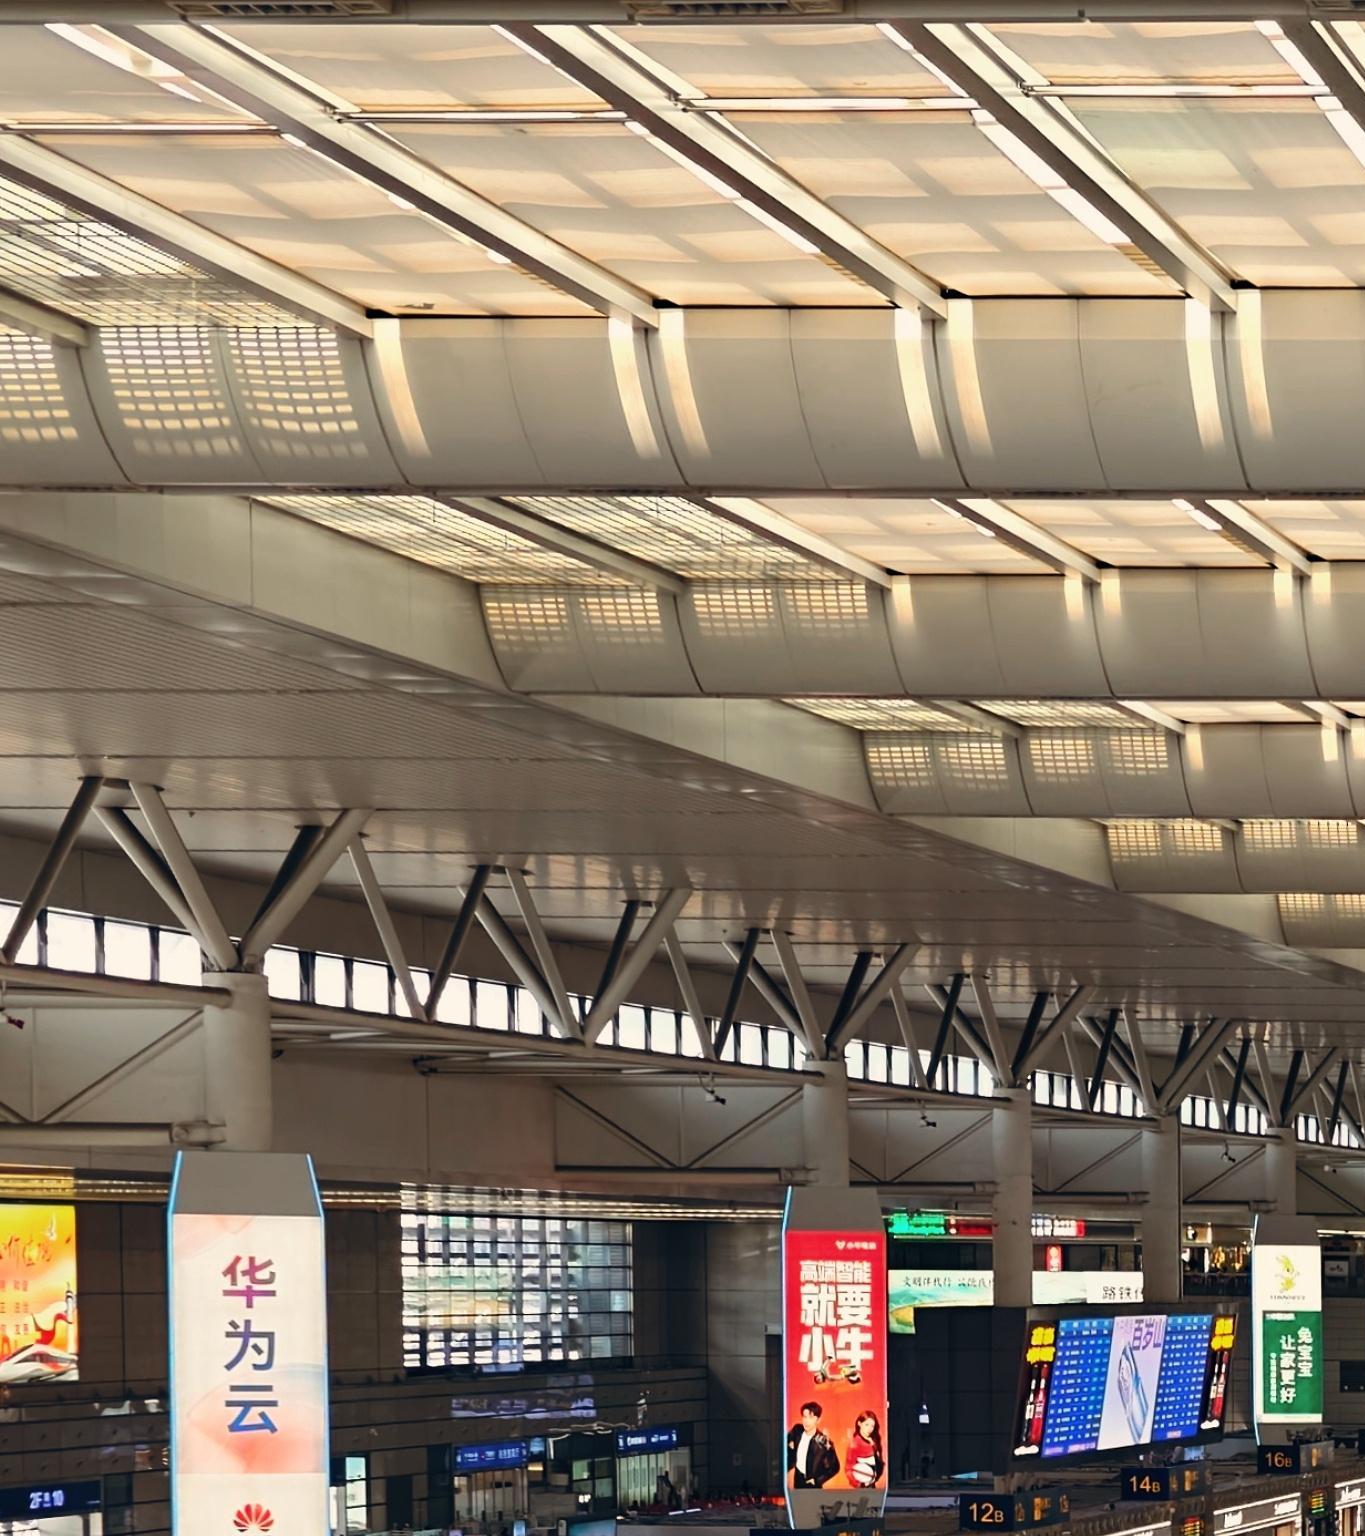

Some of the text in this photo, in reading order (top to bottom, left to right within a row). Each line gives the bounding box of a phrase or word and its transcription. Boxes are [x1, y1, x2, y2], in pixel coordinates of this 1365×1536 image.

[799, 1260, 872, 1283] 高端智能
[799, 1283, 872, 1327] 就要
[221, 1255, 279, 1434] 华为云
[798, 1327, 874, 1373] 小牛
[1297, 1326, 1313, 1378] 兔宝宝
[1279, 1334, 1297, 1404] 让家更好
[1265, 1452, 1293, 1468] 16B
[1129, 1475, 1161, 1494] 14B
[968, 1502, 1005, 1524] 12B
